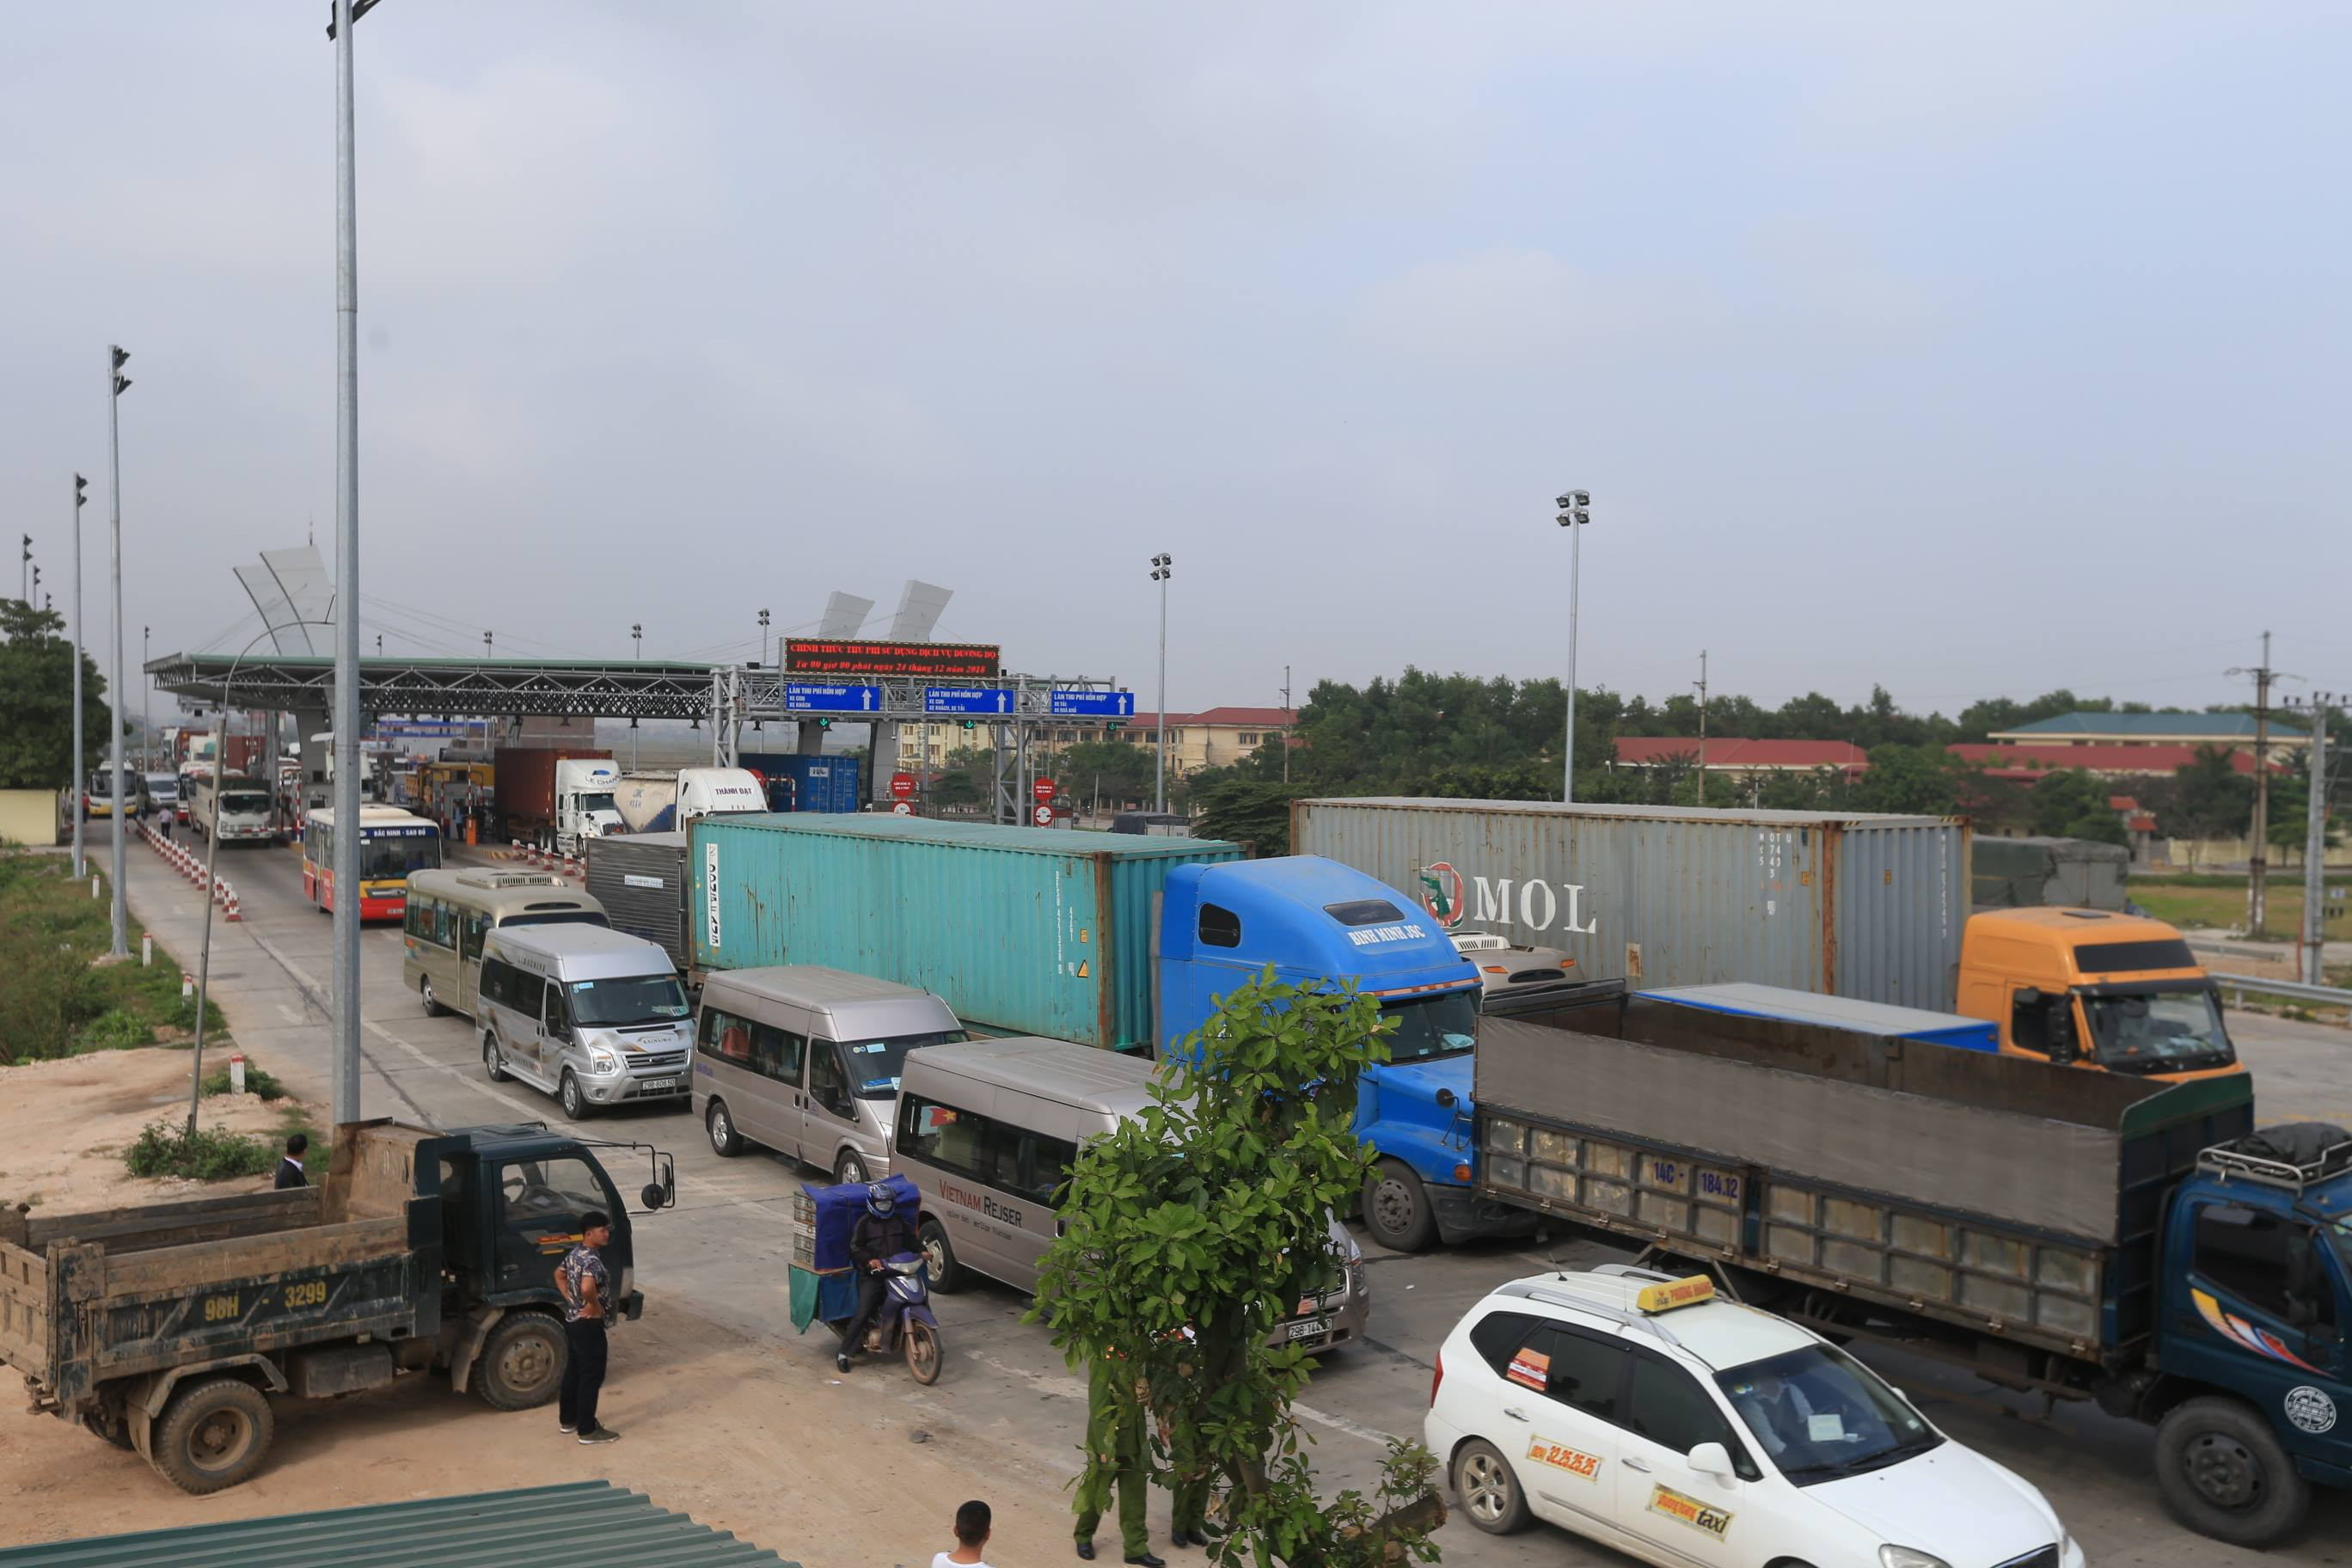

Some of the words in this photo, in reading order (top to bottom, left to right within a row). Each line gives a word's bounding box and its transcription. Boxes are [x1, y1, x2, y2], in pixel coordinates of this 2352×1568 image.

[1473, 876, 1596, 934] MOL
[1374, 926, 1408, 942] MINH
[1403, 924, 1426, 939] JSC
[1654, 1161, 1675, 1184] 14C
[1701, 1172, 1738, 1198] 184.12
[285, 1280, 327, 1308] 3299
[1697, 1508, 1730, 1534] taxi
